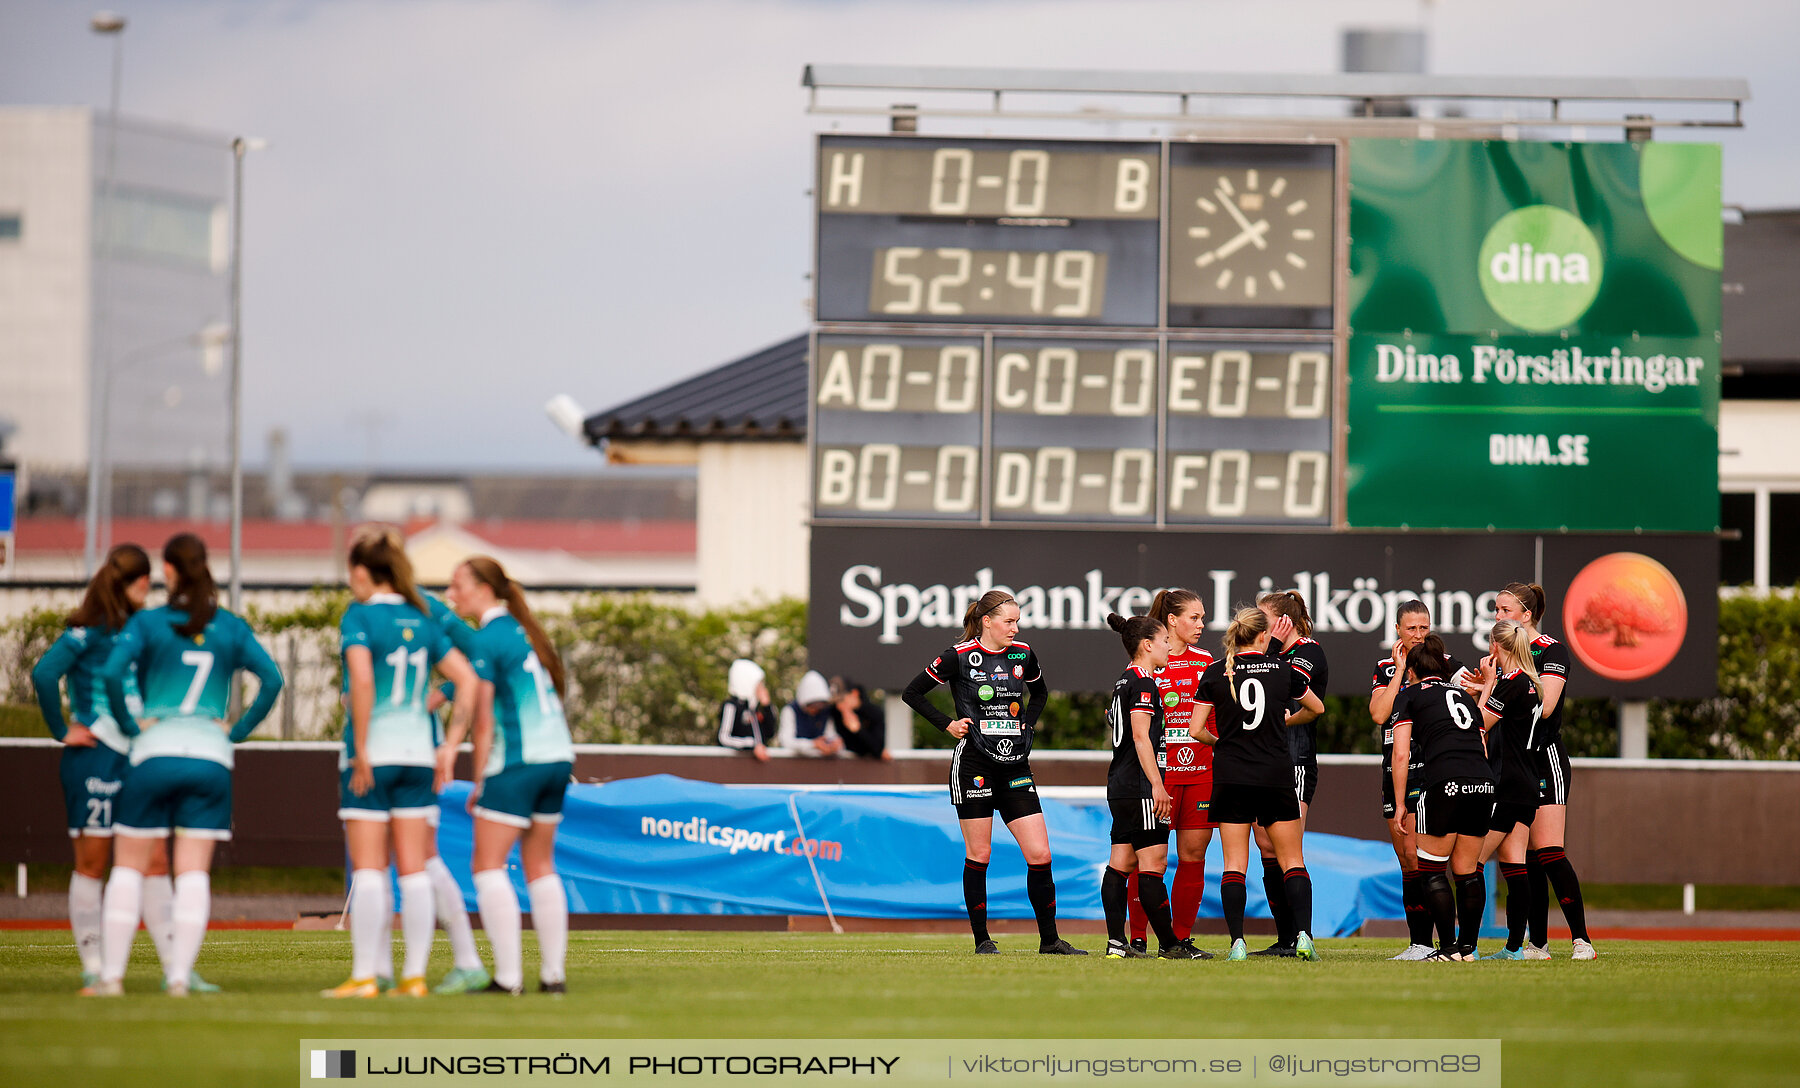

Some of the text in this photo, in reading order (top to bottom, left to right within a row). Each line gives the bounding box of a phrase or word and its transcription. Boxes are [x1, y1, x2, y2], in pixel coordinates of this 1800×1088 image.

[828, 152, 864, 206] H
[1115, 158, 1150, 212] B
[883, 246, 1095, 317] 52:49
[1490, 243, 1590, 285] dina
[1375, 344, 1705, 394] Dina Försäkringar
[1489, 434, 1590, 466] DINA.SE
[840, 564, 1183, 644] Sparanke
[179, 650, 214, 714] 7
[385, 645, 428, 710] 11
[987, 721, 1017, 730] PEAB
[1239, 677, 1266, 731] 9
[1446, 689, 1473, 730] 6
[87, 797, 112, 827] 21
[641, 816, 842, 862] nordicsport.com
